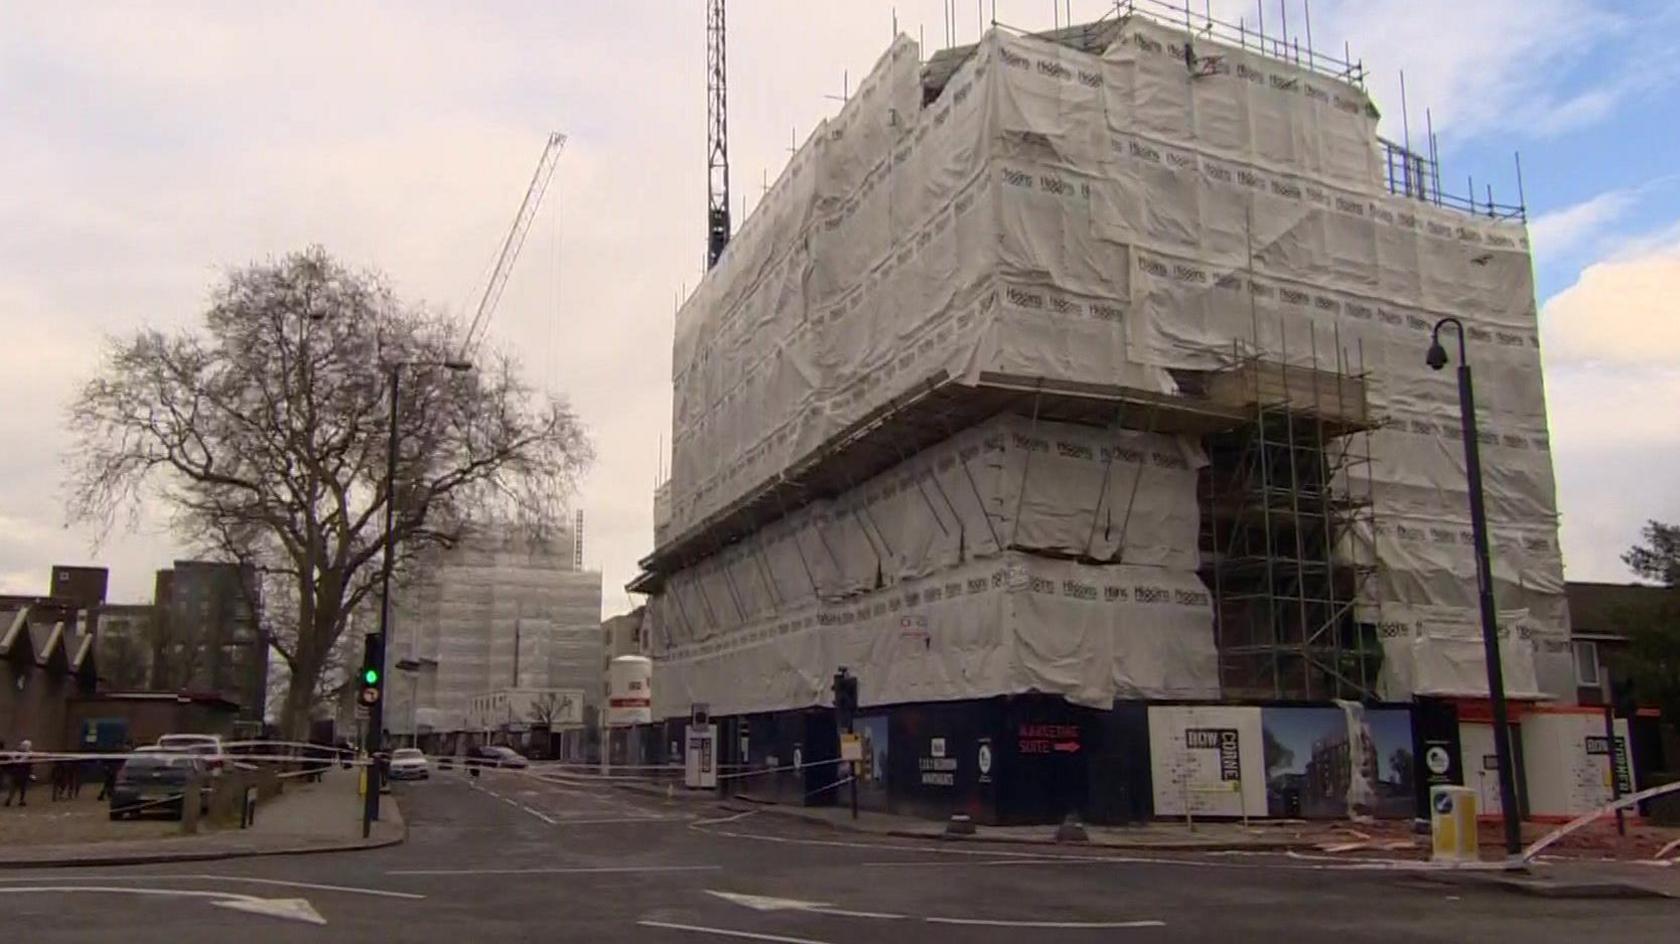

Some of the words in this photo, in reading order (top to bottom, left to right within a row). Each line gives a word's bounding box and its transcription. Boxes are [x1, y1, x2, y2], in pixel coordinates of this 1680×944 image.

[1005, 285, 1043, 309] Higgins
[1062, 580, 1098, 602] Higgins
[1134, 586, 1170, 604] Higgins
[1174, 588, 1209, 607] Higgins
